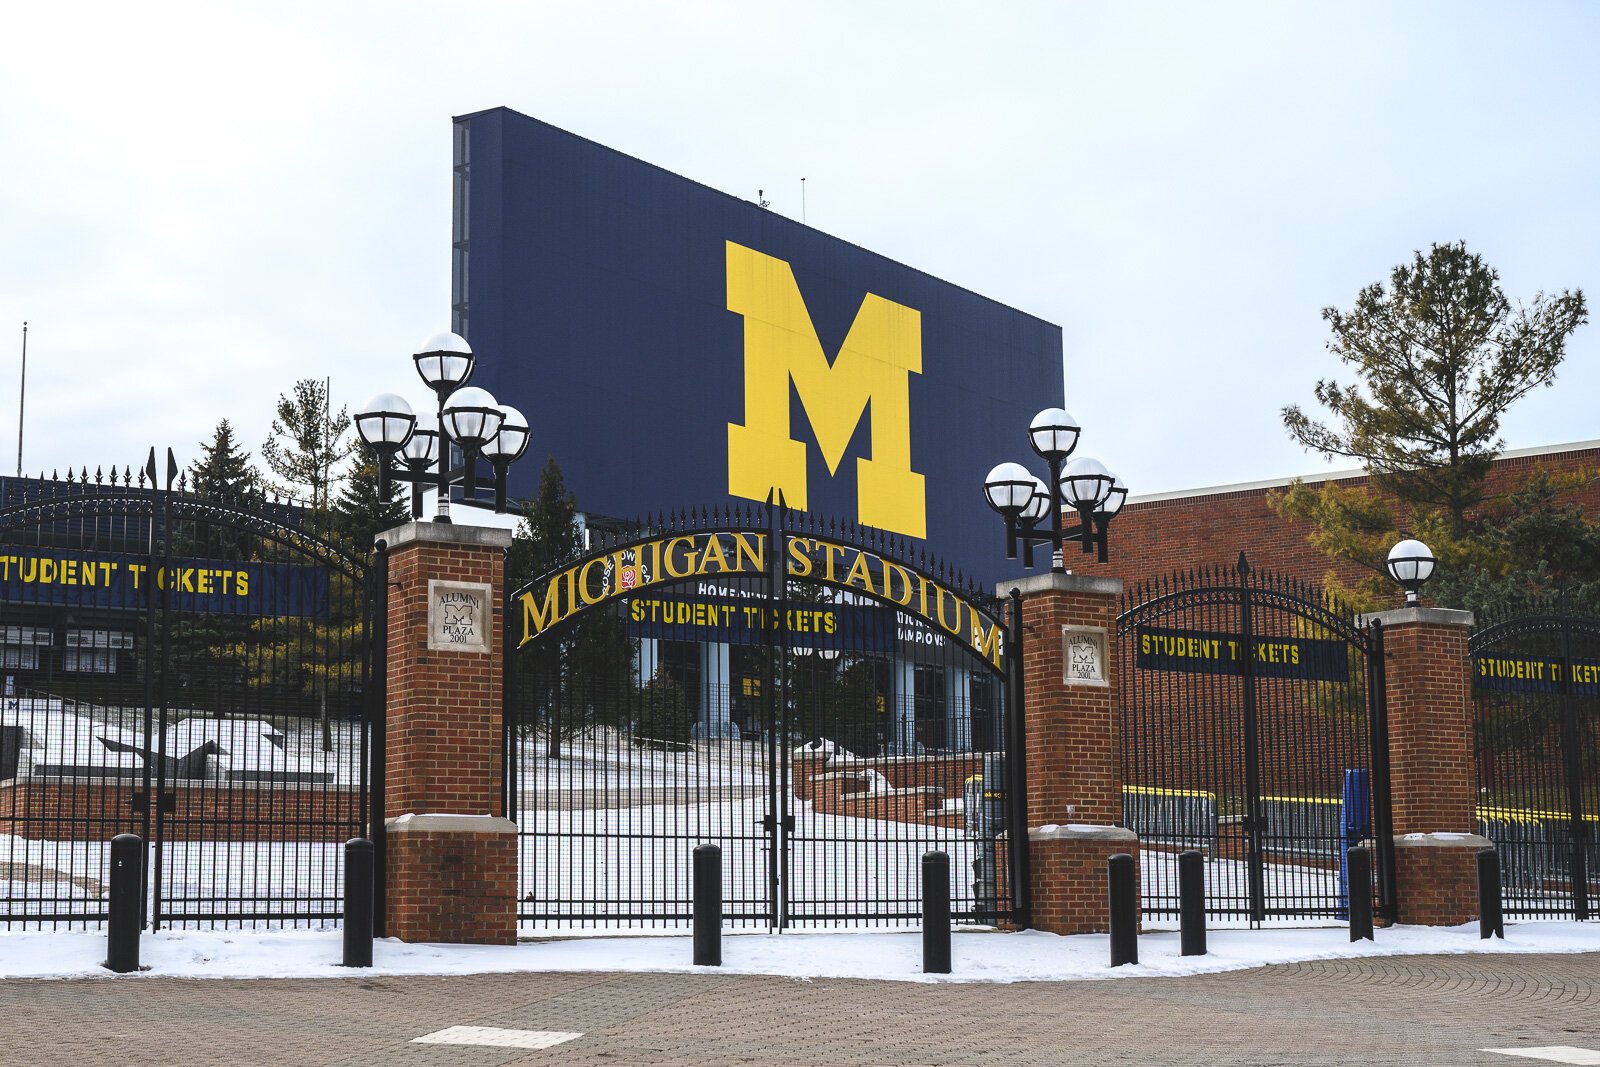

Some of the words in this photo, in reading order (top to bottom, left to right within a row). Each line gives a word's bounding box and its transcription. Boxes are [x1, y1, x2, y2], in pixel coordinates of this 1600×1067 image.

[726, 240, 926, 539] M
[0, 556, 118, 587] TUDENT
[129, 564, 249, 596] TCKETS
[439, 593, 479, 609] ALUMNI
[516, 533, 767, 649] MICHIGAN
[786, 537, 1004, 673] STADIUM
[445, 604, 473, 626] M
[631, 598, 736, 628] STUDENT
[443, 625, 474, 636] PLAZA
[450, 634, 467, 644] 2001
[1068, 635, 1098, 650] ALUMNI
[1142, 634, 1222, 660] STUDENT
[1228, 641, 1299, 665] TIKETS
[1073, 646, 1095, 665] M
[1072, 664, 1096, 673] PLAZA
[1077, 671, 1091, 680] 2001
[1478, 658, 1544, 679] STUDENT
[1549, 663, 1600, 684] TIKET
